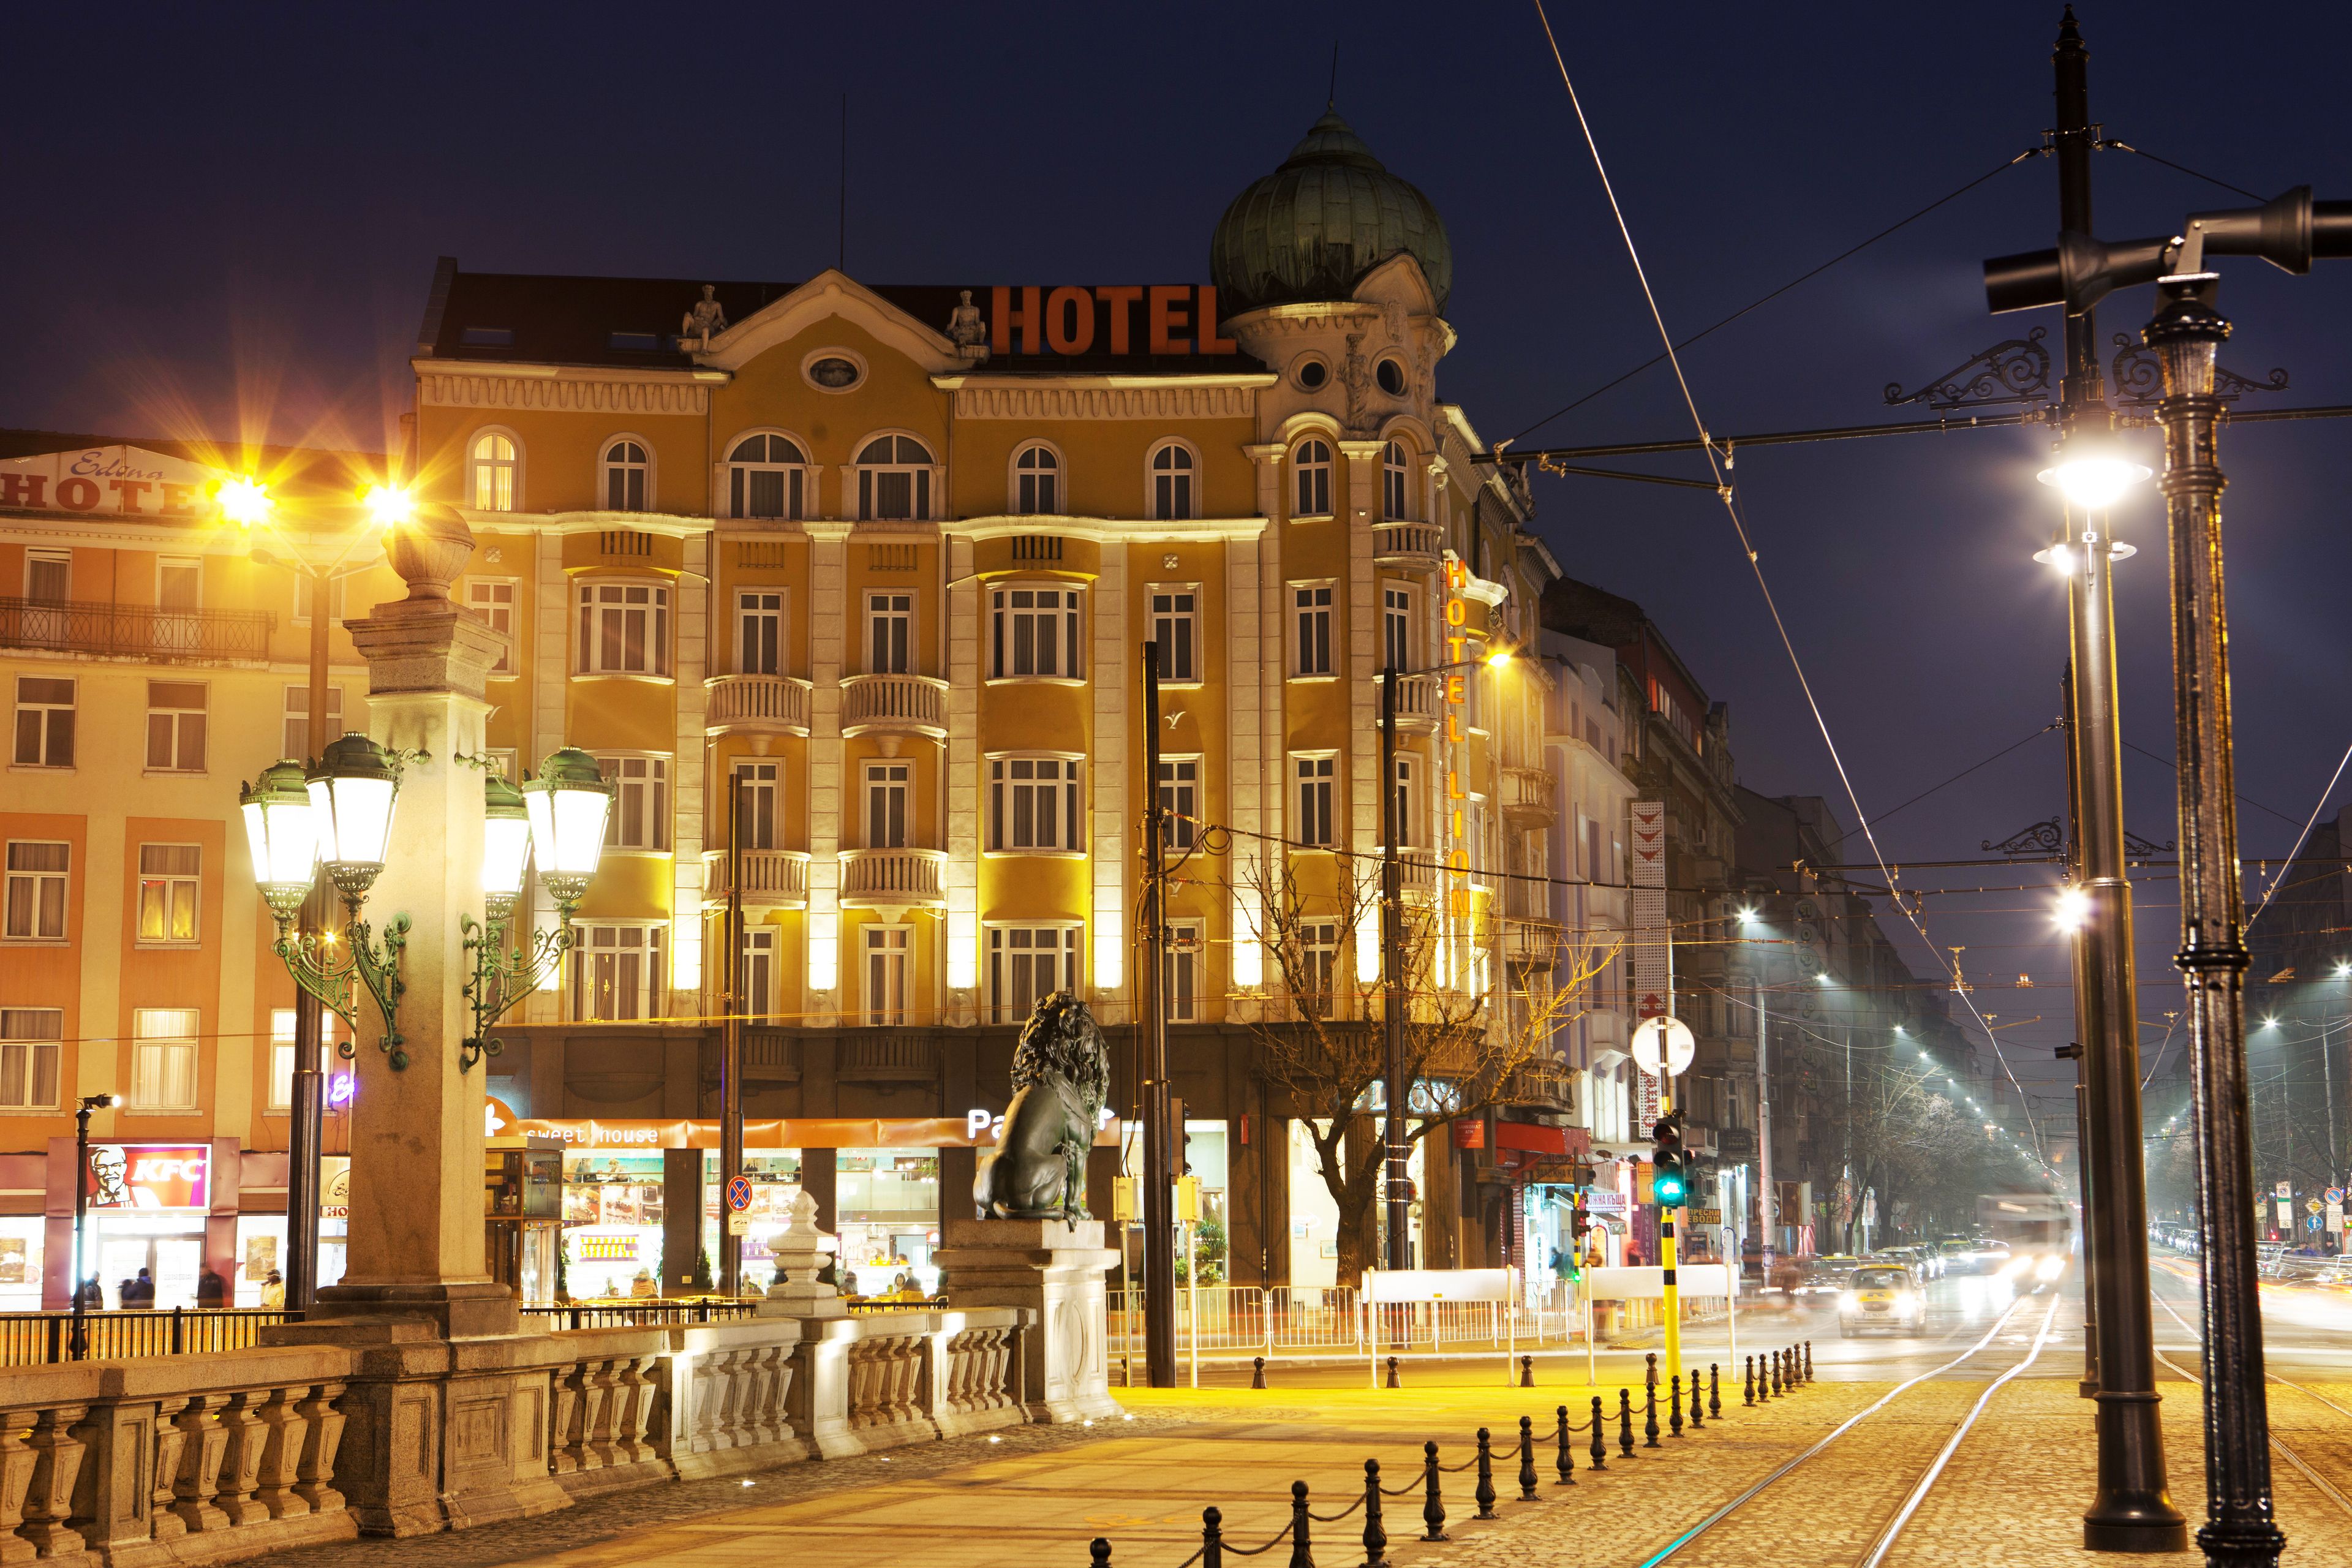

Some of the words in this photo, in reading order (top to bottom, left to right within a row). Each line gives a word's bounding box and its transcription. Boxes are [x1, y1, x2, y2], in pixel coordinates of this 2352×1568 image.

[992, 285, 1237, 355] HOTEL
[0, 473, 224, 517] HOTE
[1446, 560, 1466, 742] HOTEL
[1450, 771, 1470, 917] LION
[1640, 1068, 1657, 1128] Carref
[527, 1126, 584, 1142] sweet
[600, 1126, 658, 1143] house
[968, 1109, 1005, 1139] Pa
[130, 1159, 202, 1182] KFC
[1639, 1164, 1653, 1173] BIL
[327, 1207, 349, 1216] HO
[1589, 1194, 1606, 1205] ОЖНА
